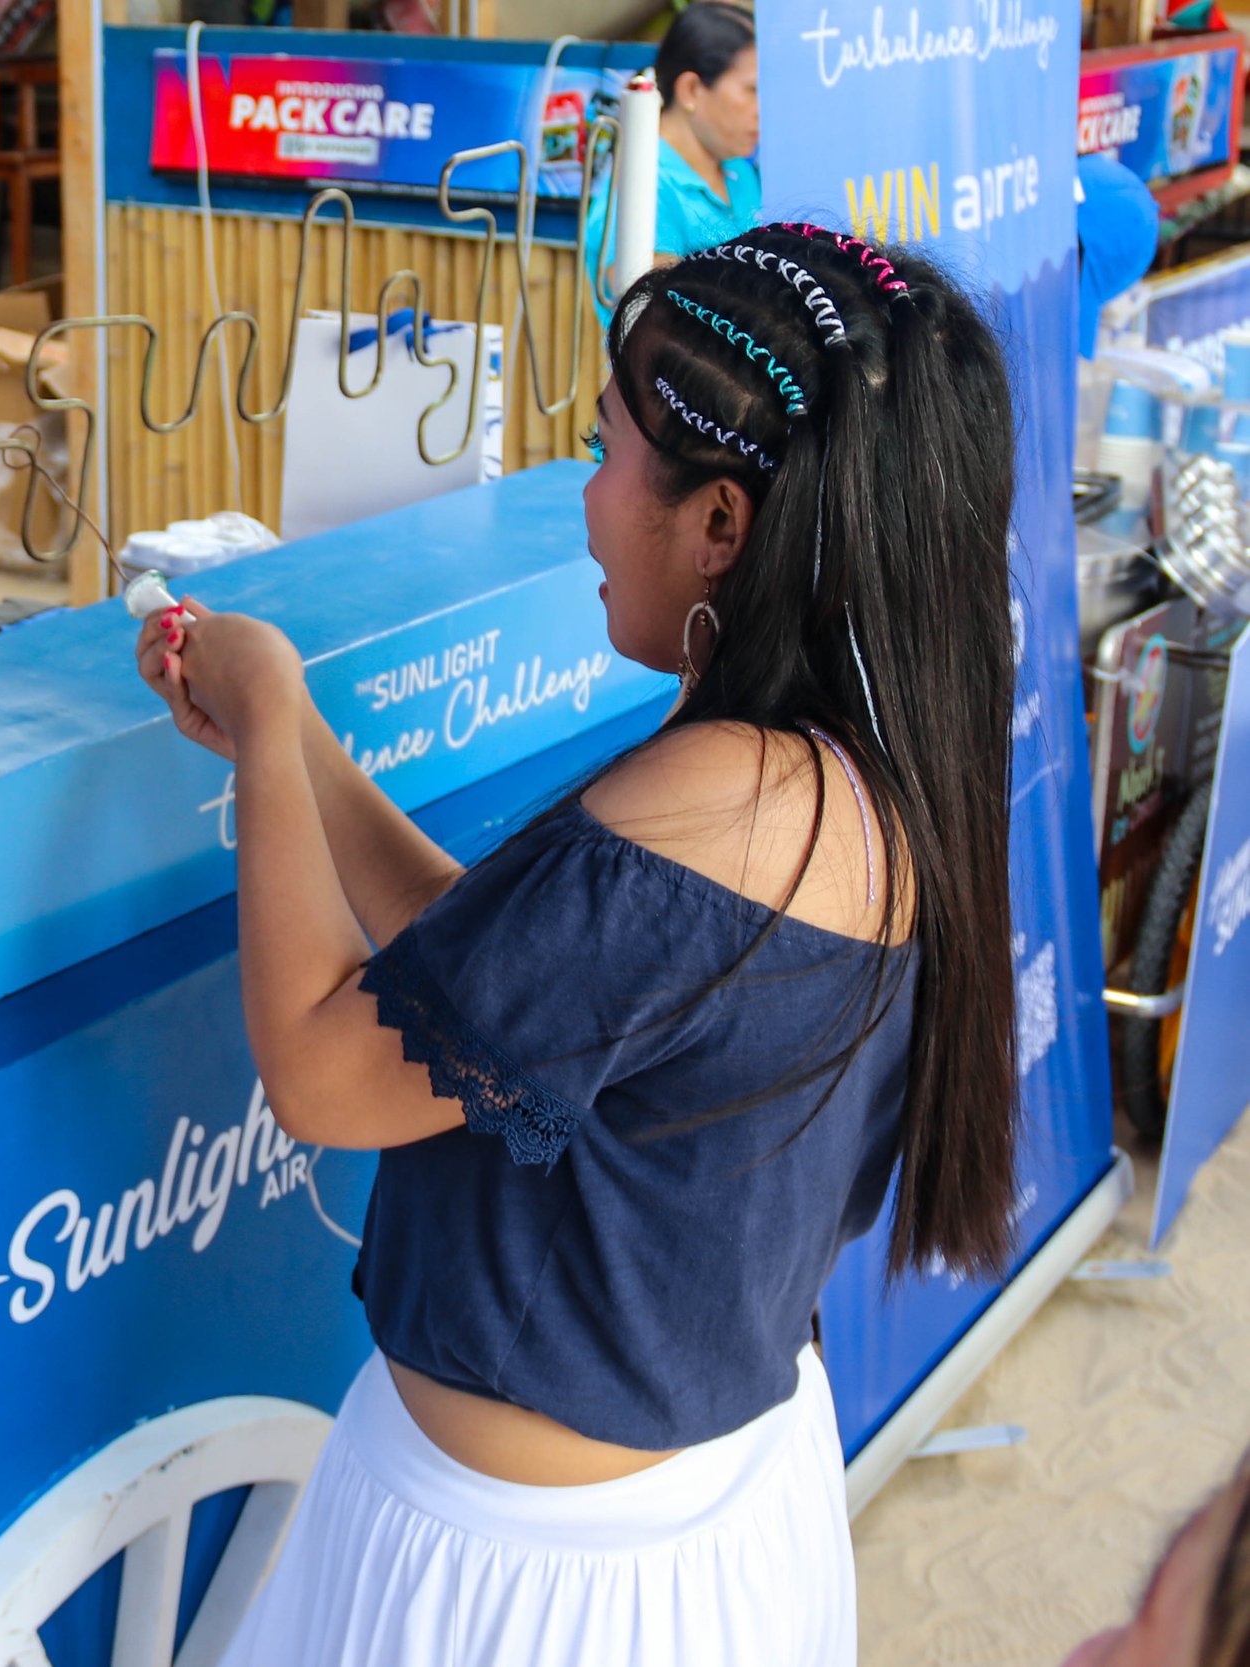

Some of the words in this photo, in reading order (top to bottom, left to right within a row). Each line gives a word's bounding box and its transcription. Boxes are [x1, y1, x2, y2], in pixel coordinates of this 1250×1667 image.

[230, 94, 330, 132] PACK
[330, 99, 435, 140] CARE
[846, 162, 939, 246] WIN
[371, 629, 501, 711] SUNLIGHT
[444, 651, 611, 749] Challenge
[260, 1152, 308, 1211] AIR
